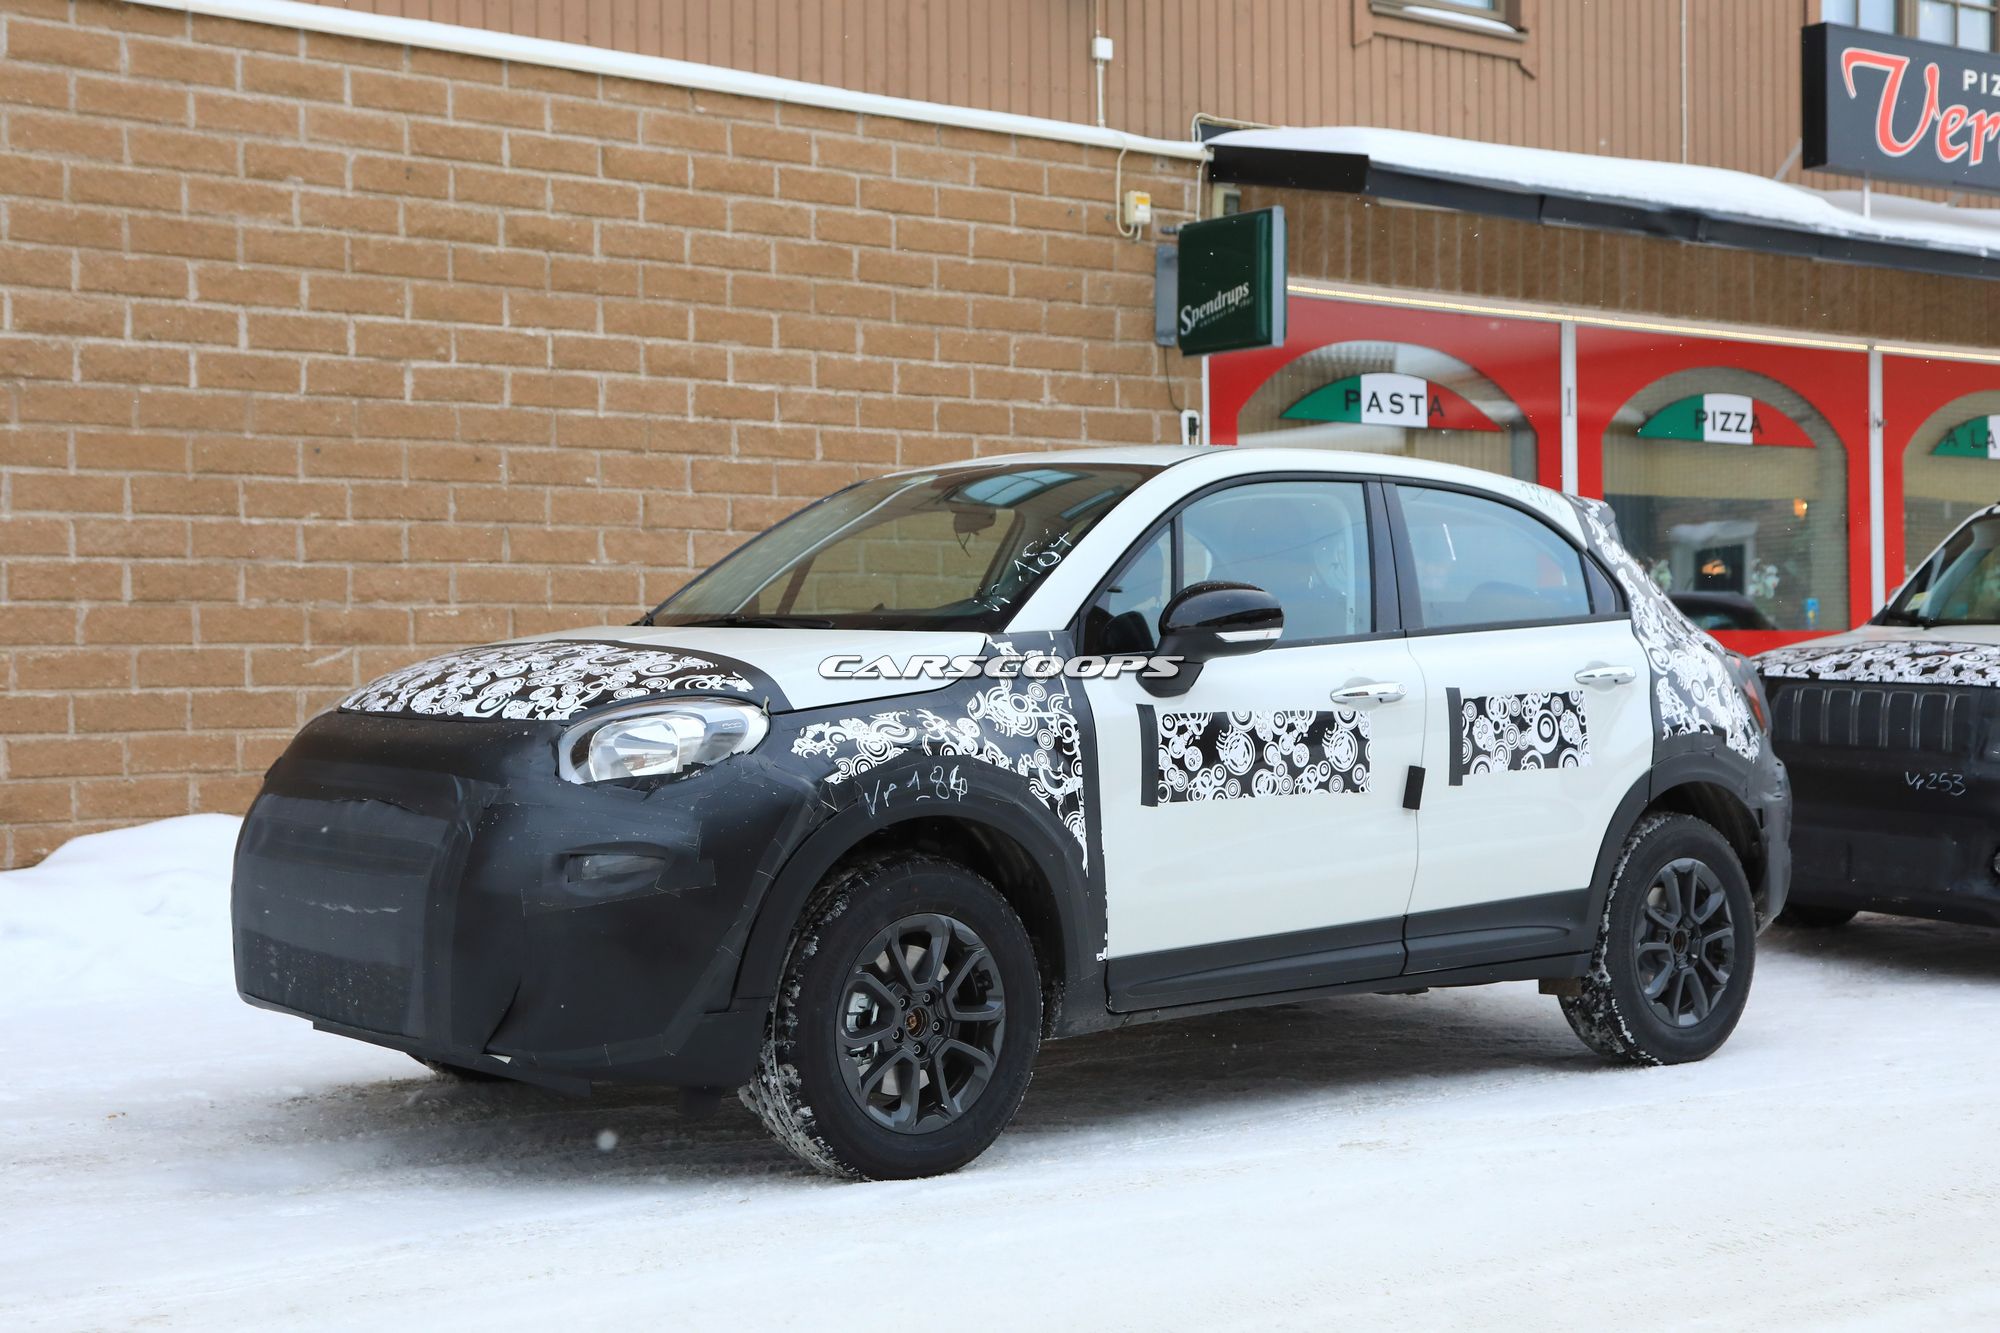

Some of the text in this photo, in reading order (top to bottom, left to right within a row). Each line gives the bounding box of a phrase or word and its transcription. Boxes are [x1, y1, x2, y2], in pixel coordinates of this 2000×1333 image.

[1840, 47, 2000, 166] Ver
[1180, 282, 1249, 335] Spendrups
[1344, 389, 1444, 417] PASTA
[1695, 408, 1764, 435] PIZZA
